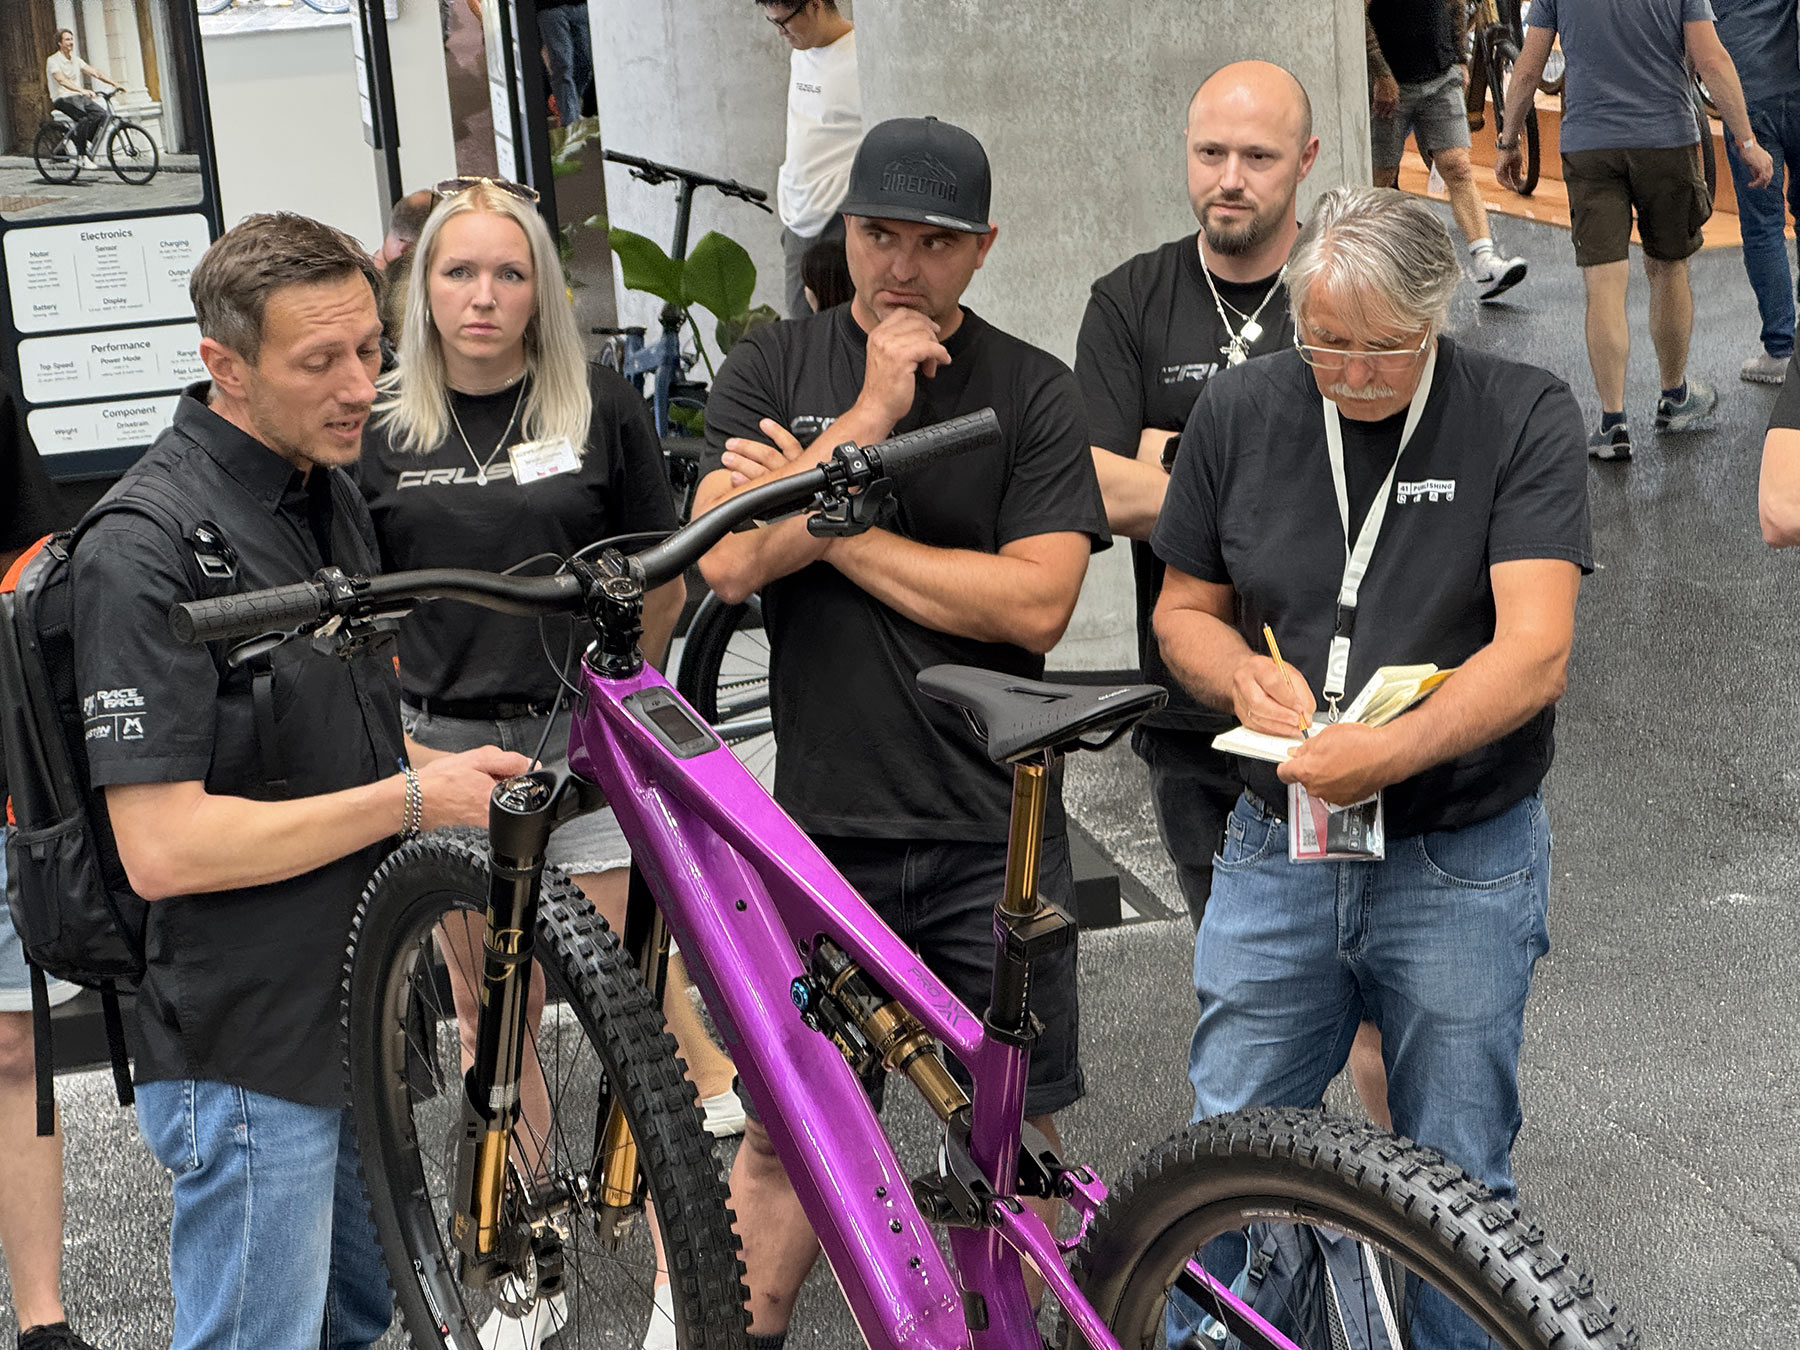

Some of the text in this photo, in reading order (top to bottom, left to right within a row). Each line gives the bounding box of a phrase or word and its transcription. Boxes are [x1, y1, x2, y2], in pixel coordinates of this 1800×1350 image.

[881, 172, 957, 202] DIRECTOR
[80, 229, 133, 241] Electronics
[160, 240, 189, 248] Charging
[102, 297, 127, 305] Display
[33, 304, 57, 312] Battery
[91, 341, 151, 353] Performance
[40, 361, 74, 371] Top Speed
[102, 406, 157, 418] Component
[116, 420, 149, 429] Drivetrain
[54, 427, 78, 436] Weight
[1413, 482, 1453, 492] PUBLISHING
[97, 688, 138, 700] RACE
[103, 696, 145, 709] FACE
